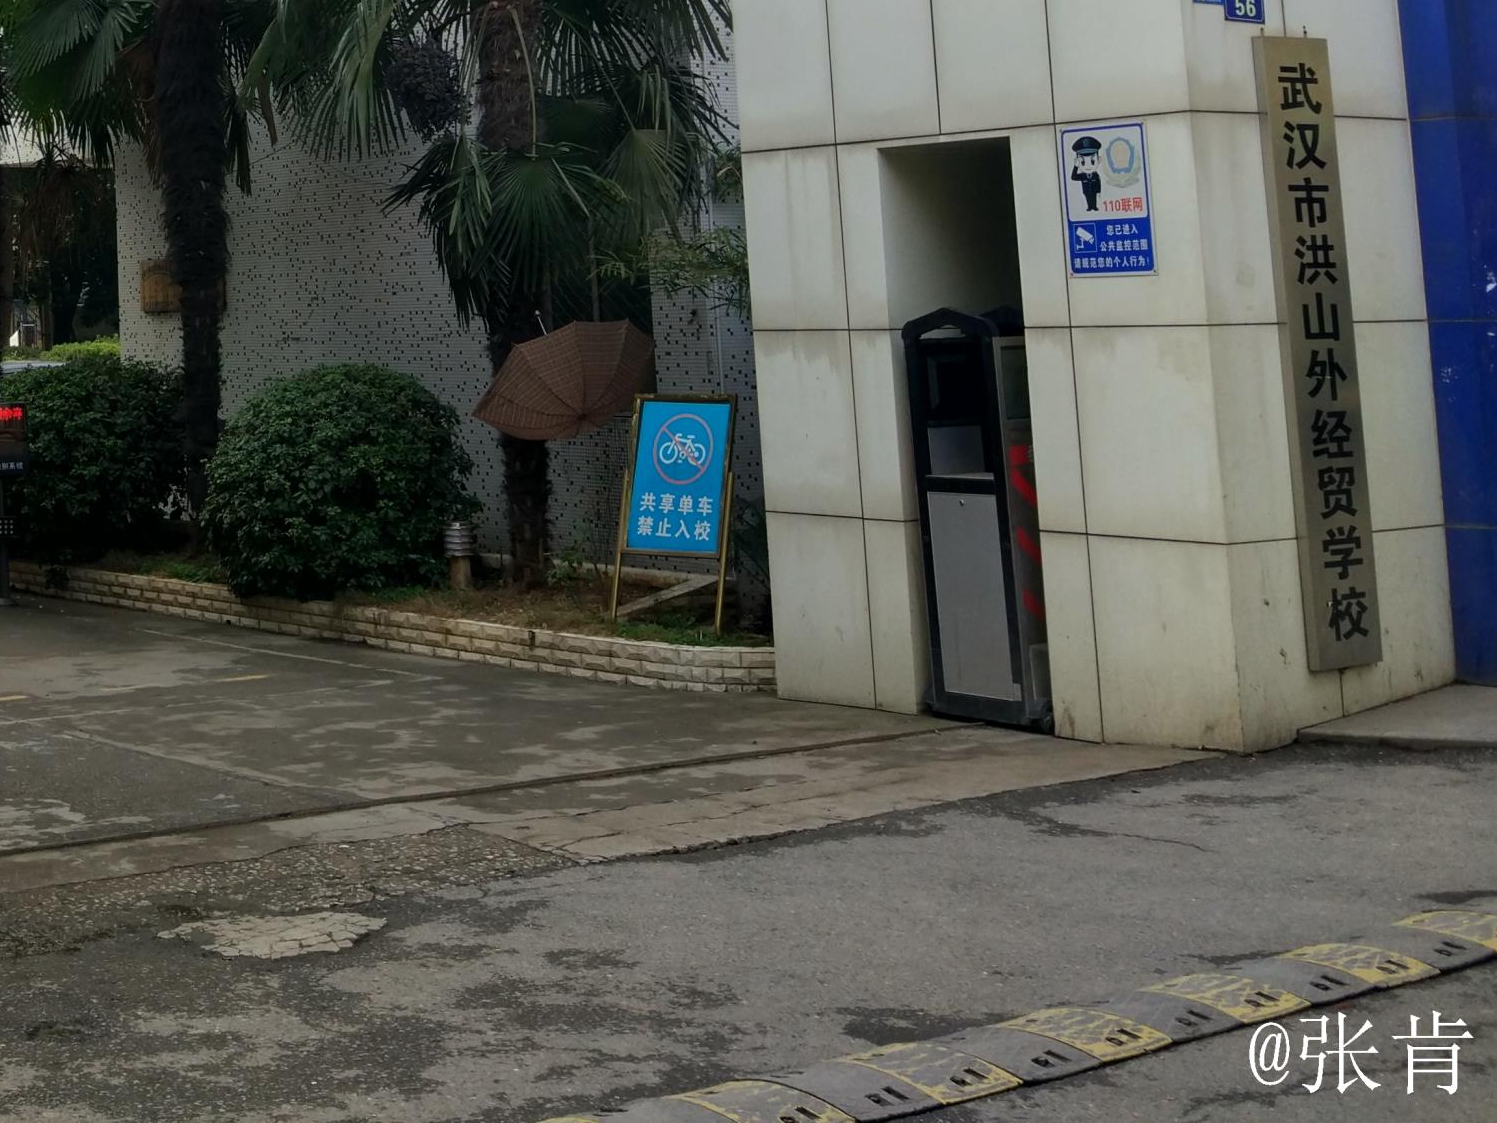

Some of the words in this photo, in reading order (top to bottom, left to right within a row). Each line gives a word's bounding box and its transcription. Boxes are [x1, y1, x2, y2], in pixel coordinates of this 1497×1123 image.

[1103, 197, 1143, 212] 110联网
[1106, 223, 1139, 236] 您已进入
[1100, 239, 1148, 252] 公共监控范围
[1278, 62, 1369, 643] 武汉市洪山外经贸学校
[639, 492, 714, 517] 共享单车
[636, 516, 711, 542] 禁止入校
